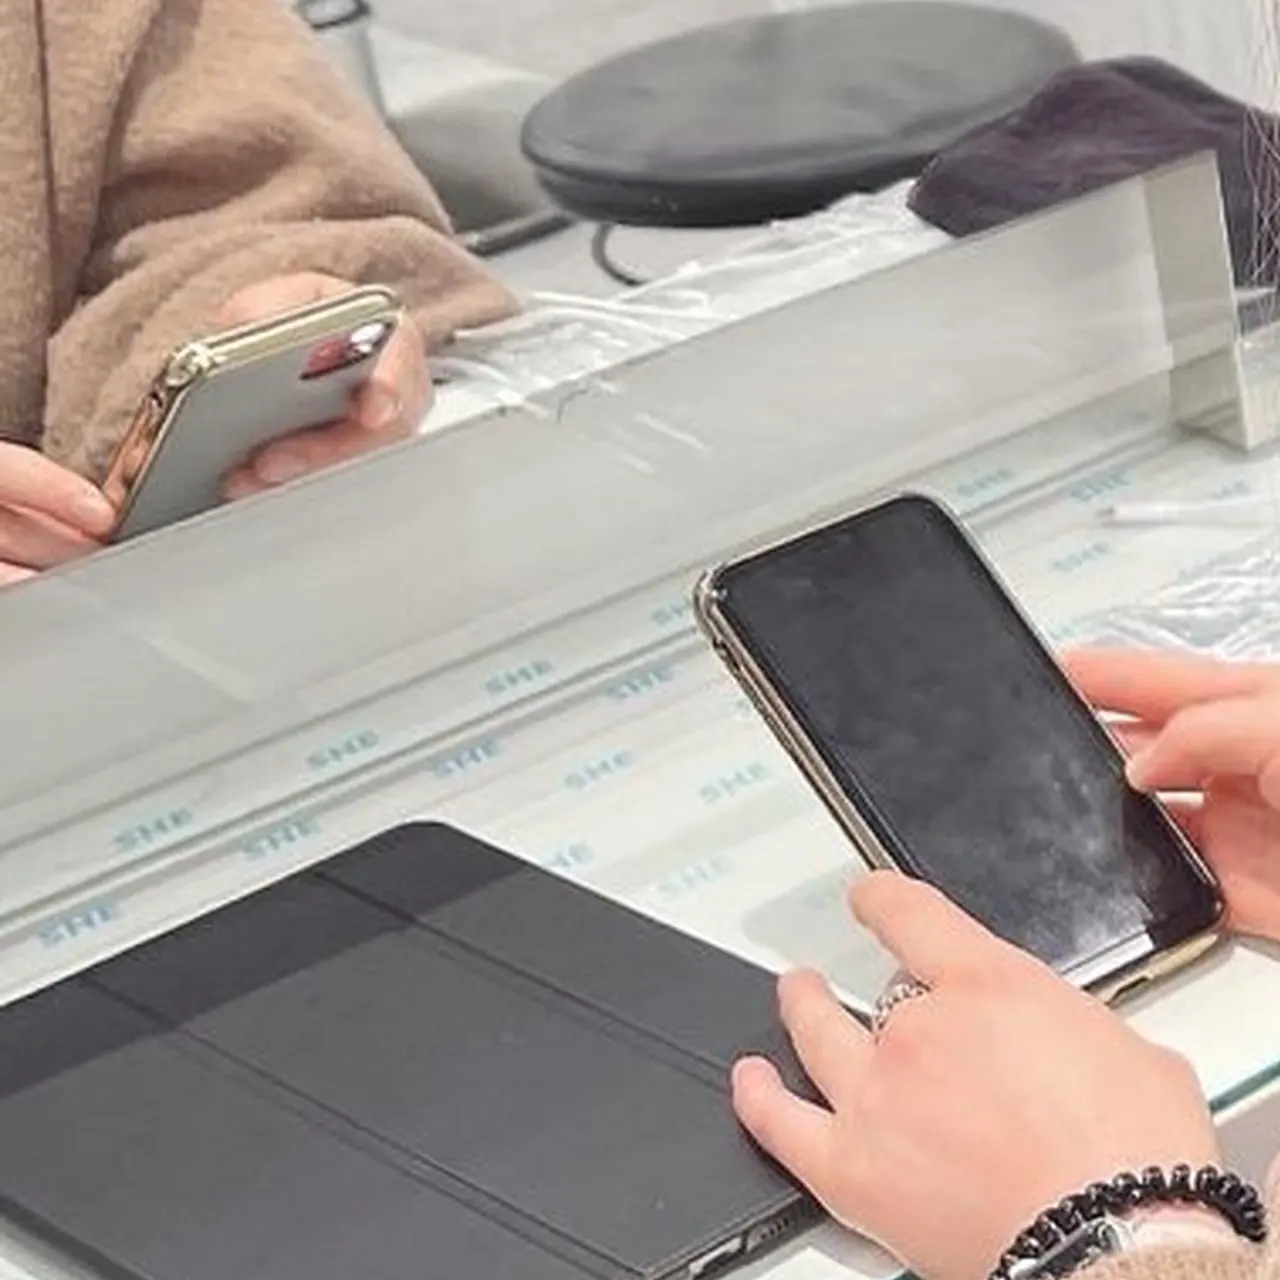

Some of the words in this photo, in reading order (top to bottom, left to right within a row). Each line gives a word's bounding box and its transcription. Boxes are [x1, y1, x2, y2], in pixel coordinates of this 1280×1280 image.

[431, 738, 503, 779] SHE
[240, 817, 319, 860] SHE
[36, 900, 121, 949] SHE
